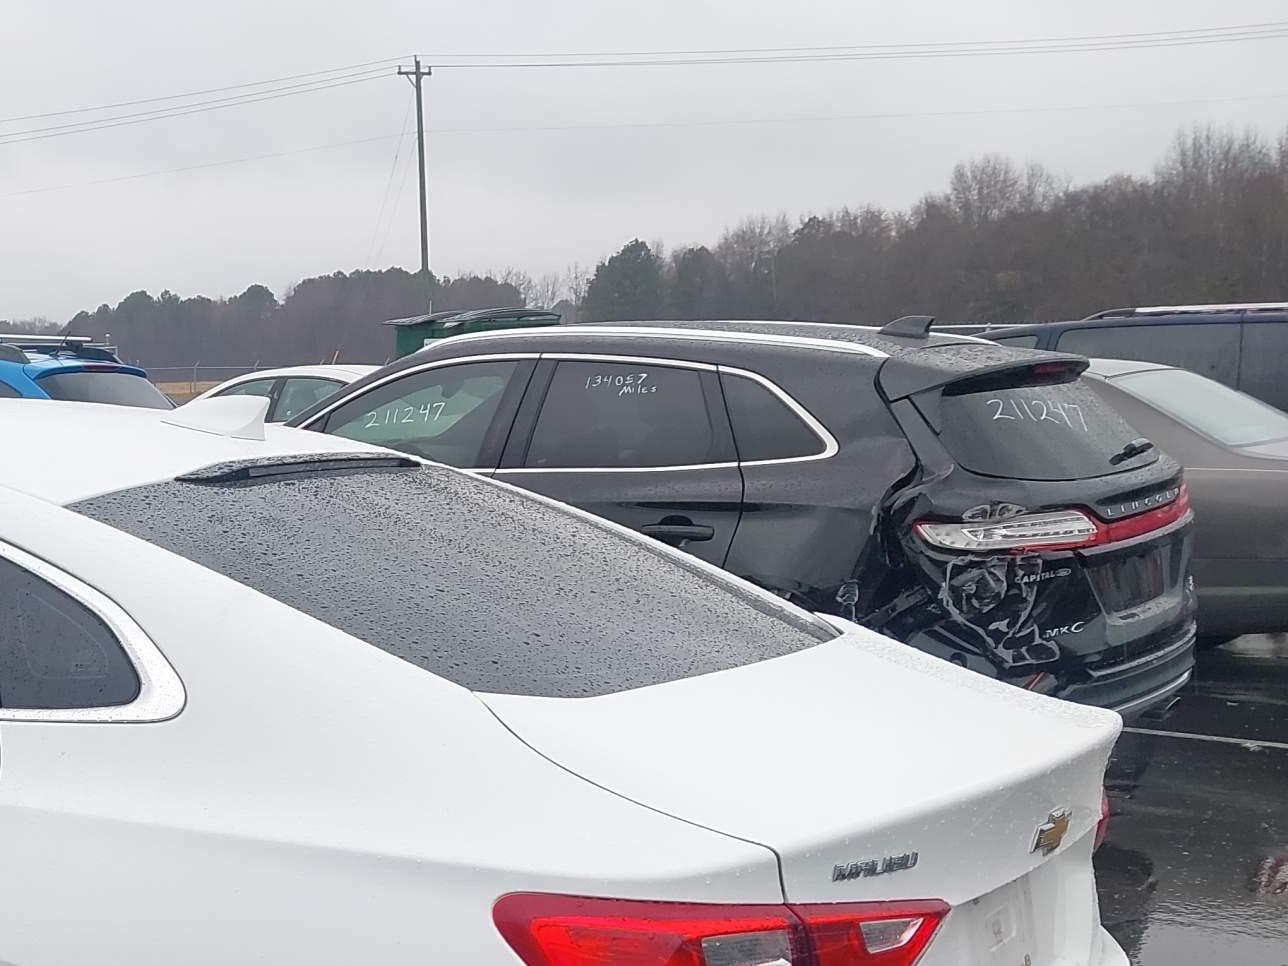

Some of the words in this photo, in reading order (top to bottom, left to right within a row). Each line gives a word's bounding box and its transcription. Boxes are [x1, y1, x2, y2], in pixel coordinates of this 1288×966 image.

[364, 401, 447, 429] 211247
[986, 399, 1089, 432] 211247
[1106, 487, 1180, 517] LINCOLN
[1014, 570, 1056, 584] CAPITAL
[1042, 621, 1086, 639] MKC
[831, 851, 920, 882] MALIBU
